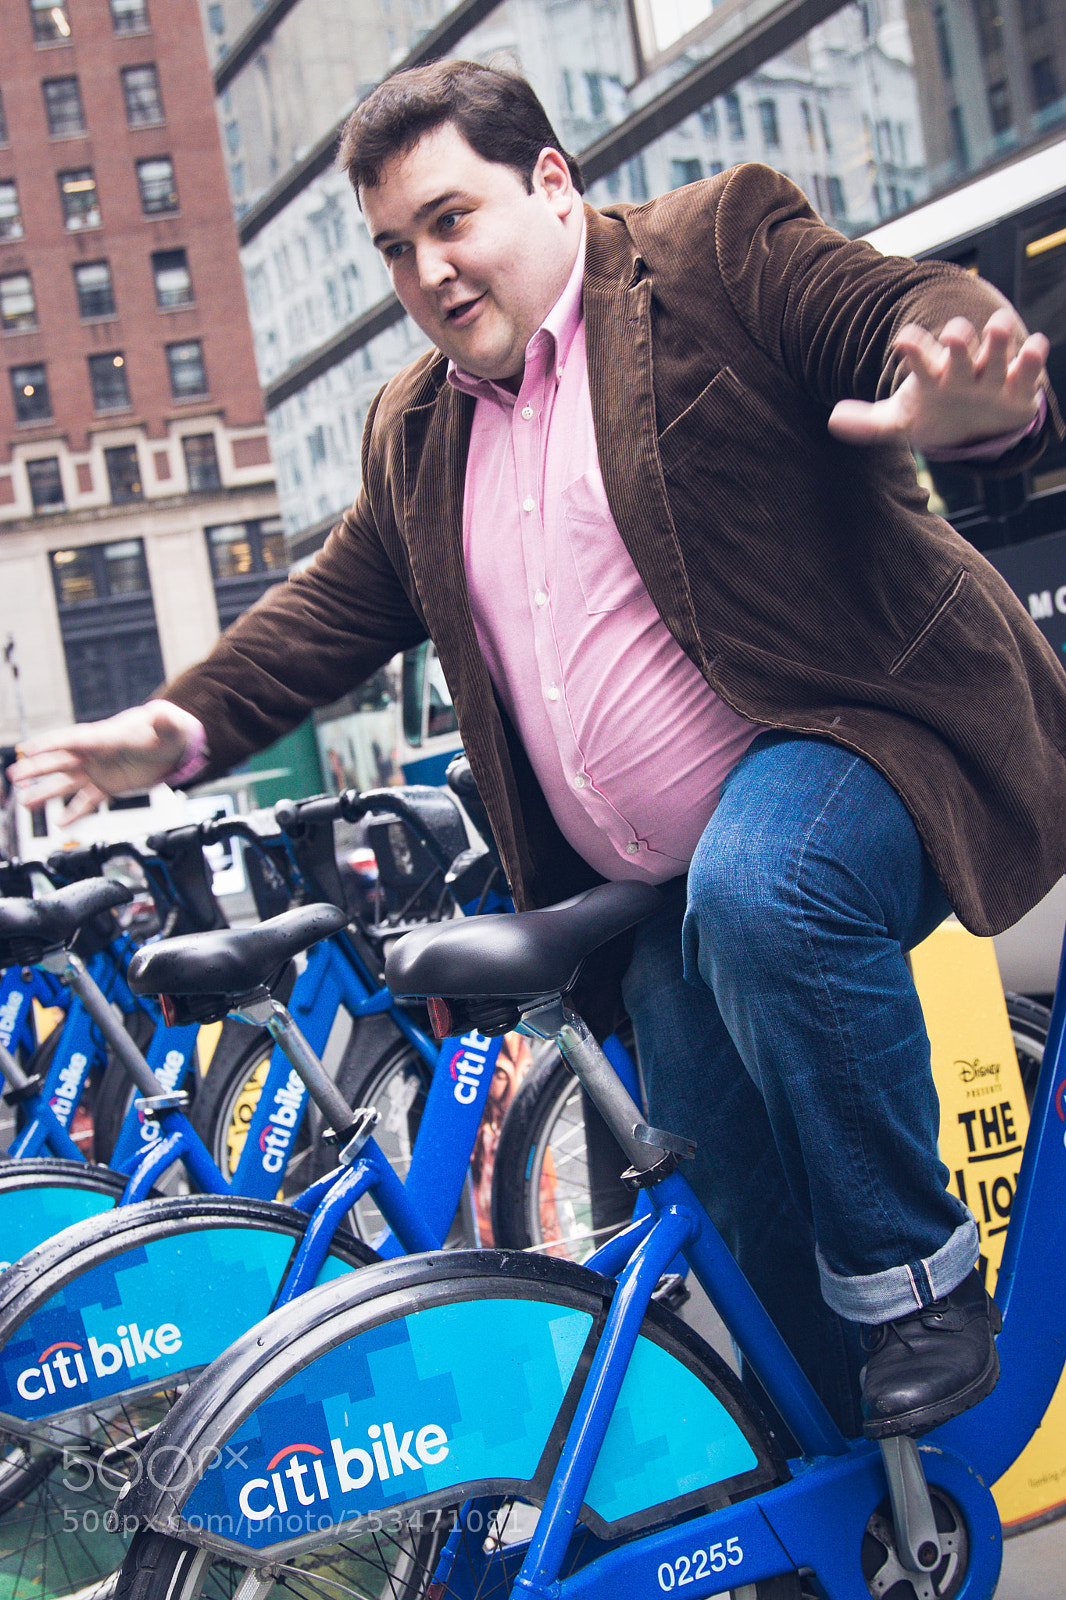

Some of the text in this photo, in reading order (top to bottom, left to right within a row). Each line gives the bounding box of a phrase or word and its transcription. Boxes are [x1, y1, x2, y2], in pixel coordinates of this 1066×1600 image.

[54, 1052, 88, 1101] bike
[154, 1050, 185, 1095] ike
[453, 1051, 487, 1105] citi
[261, 1126, 292, 1173] citi
[957, 1101, 1017, 1153] THE
[16, 1322, 183, 1401] citi bike
[238, 1421, 450, 1522] citi bike
[657, 1536, 744, 1593] 02255
